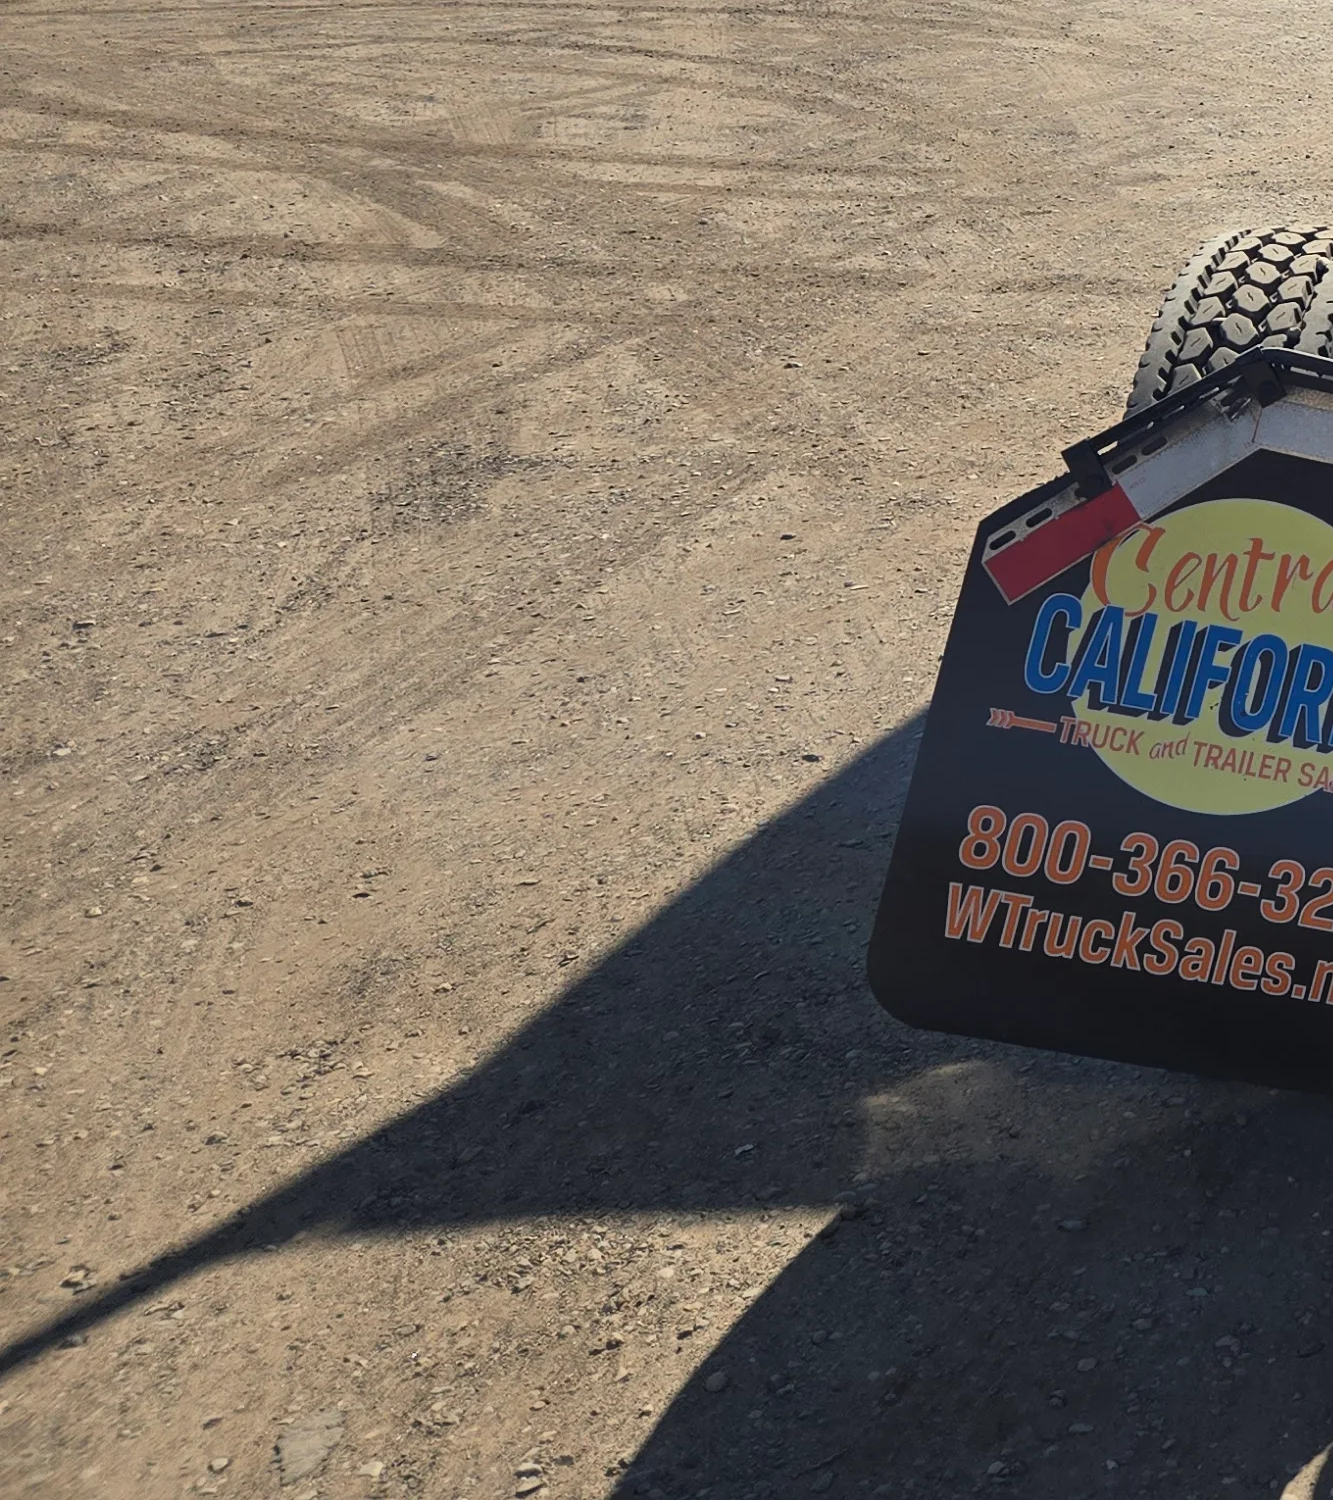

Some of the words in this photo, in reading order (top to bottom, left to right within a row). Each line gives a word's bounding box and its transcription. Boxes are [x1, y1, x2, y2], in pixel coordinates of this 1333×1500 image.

[1058, 716, 1145, 757] TRUCK
[1149, 731, 1191, 761] and
[1193, 740, 1292, 784] TRAILER
